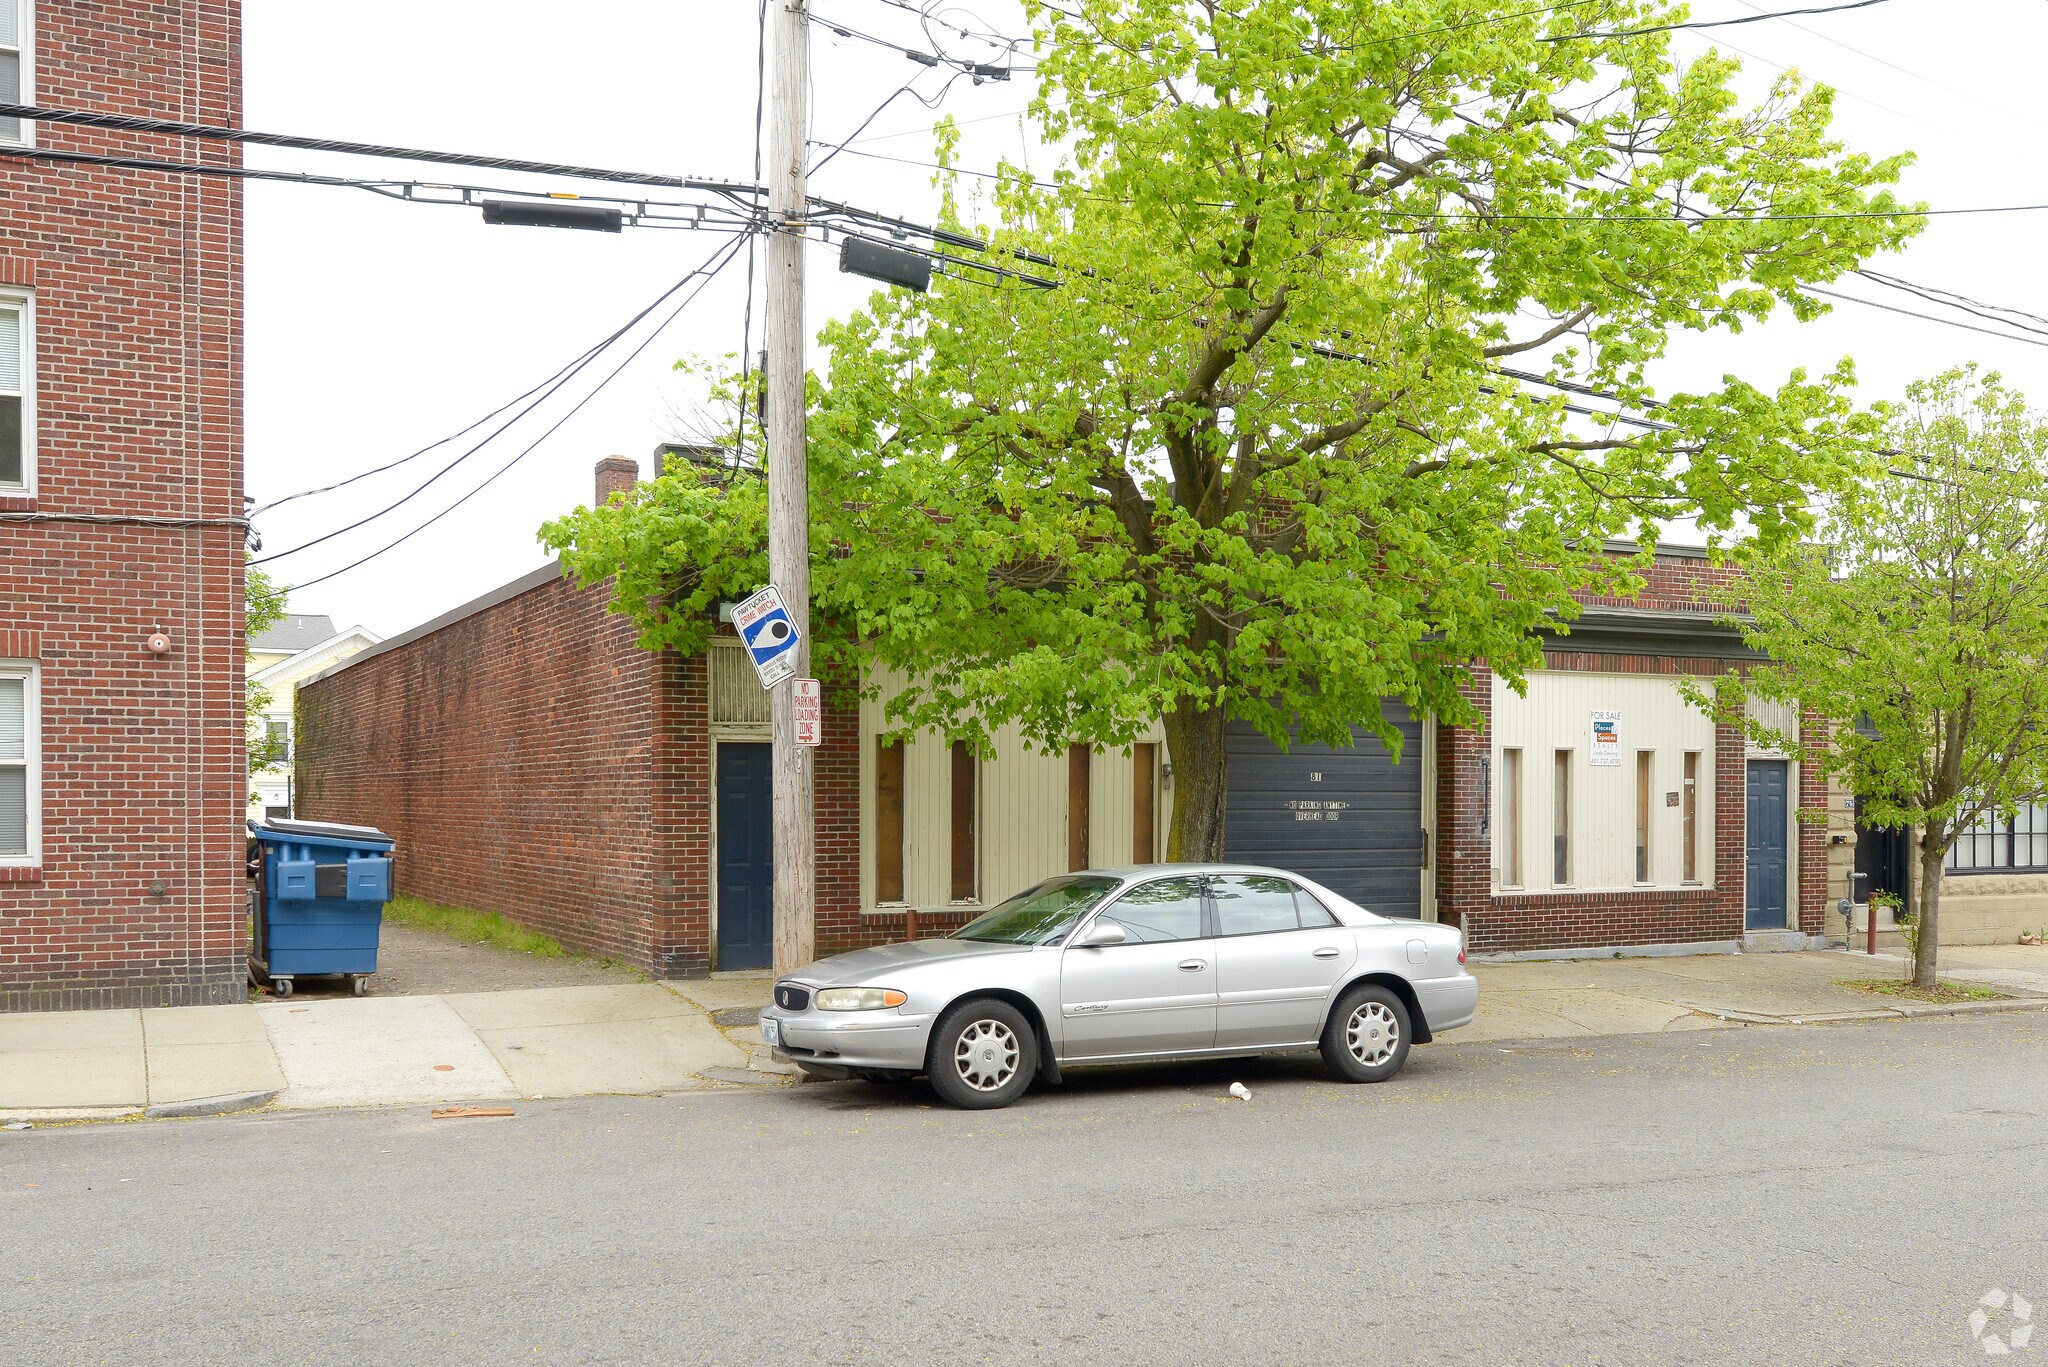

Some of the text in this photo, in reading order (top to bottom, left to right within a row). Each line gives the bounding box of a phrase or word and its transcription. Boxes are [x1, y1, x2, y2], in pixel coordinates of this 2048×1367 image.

[737, 592, 770, 617] PAWTUCKET
[739, 599, 777, 626] CRIME WATCH
[801, 683, 809, 695] NO
[795, 695, 818, 708] PARKING
[795, 708, 819, 721] LOADING
[1590, 711, 1621, 720] FOR SALE
[799, 722, 814, 735] ZONE
[1594, 723, 1611, 731] Places
[1597, 733, 1616, 742] Spaces
[1311, 772, 1321, 781] 81
[1299, 801, 1321, 809] PARKING
[1073, 1004, 1109, 1012] Century
